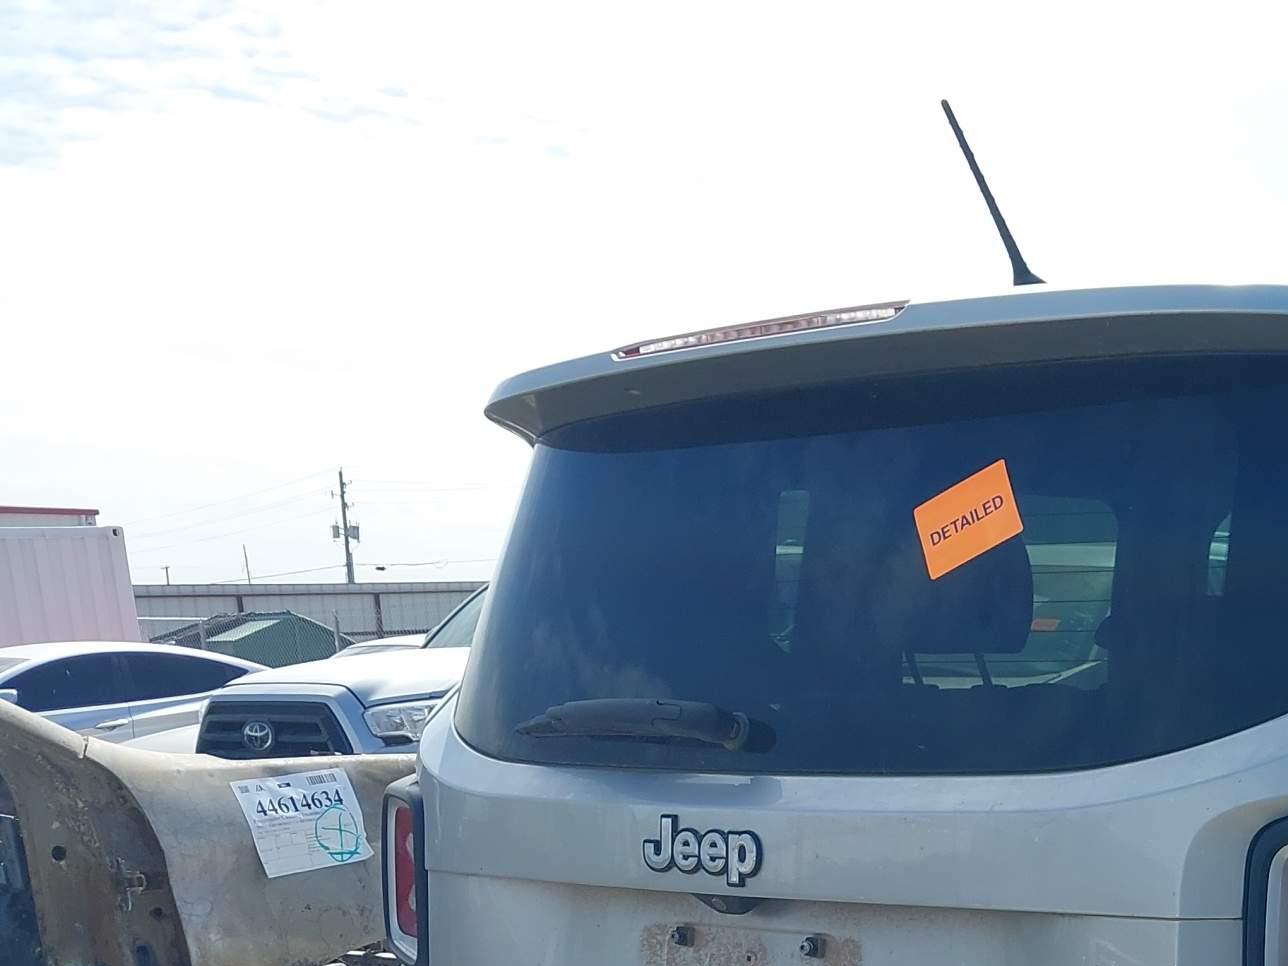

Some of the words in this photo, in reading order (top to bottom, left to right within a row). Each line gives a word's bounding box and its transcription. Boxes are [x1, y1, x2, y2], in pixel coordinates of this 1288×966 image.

[929, 494, 1004, 546] DETAILED
[256, 788, 344, 817] 44614634
[642, 814, 762, 887] Jeep
